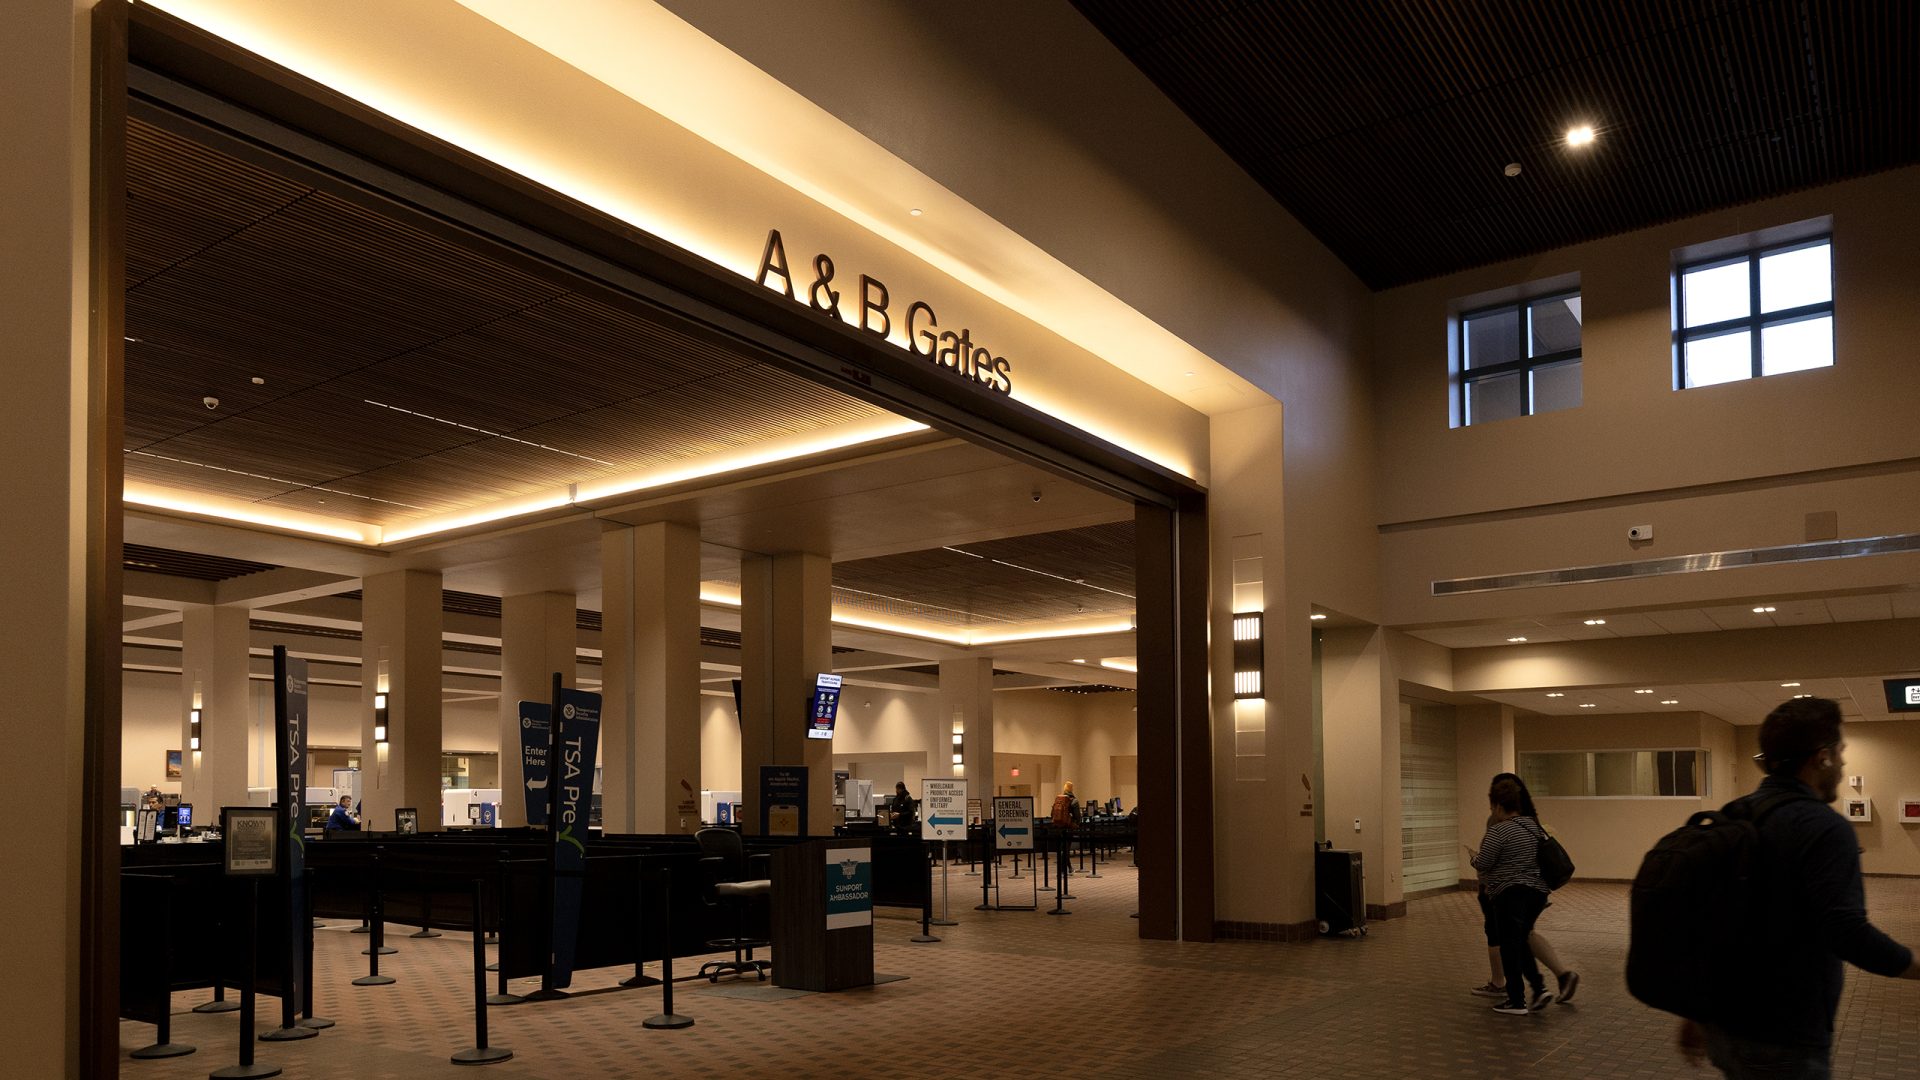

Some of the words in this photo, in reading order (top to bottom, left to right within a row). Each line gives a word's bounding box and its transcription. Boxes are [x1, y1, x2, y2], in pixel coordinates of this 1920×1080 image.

[756, 229, 796, 300] A
[808, 254, 844, 323] &
[859, 274, 891, 340] B
[905, 301, 1012, 397] Gates
[289, 714, 300, 765] TSA
[525, 745, 548, 756] Enter
[525, 756, 546, 767] Here
[563, 736, 582, 780] TSA
[290, 773, 300, 819] Pre
[562, 786, 580, 824] Pre
[998, 801, 1021, 809] GENERAL
[237, 820, 266, 828] KNOWN
[835, 883, 863, 893] SUNPORT
[829, 891, 869, 902] AMBASSADOR
